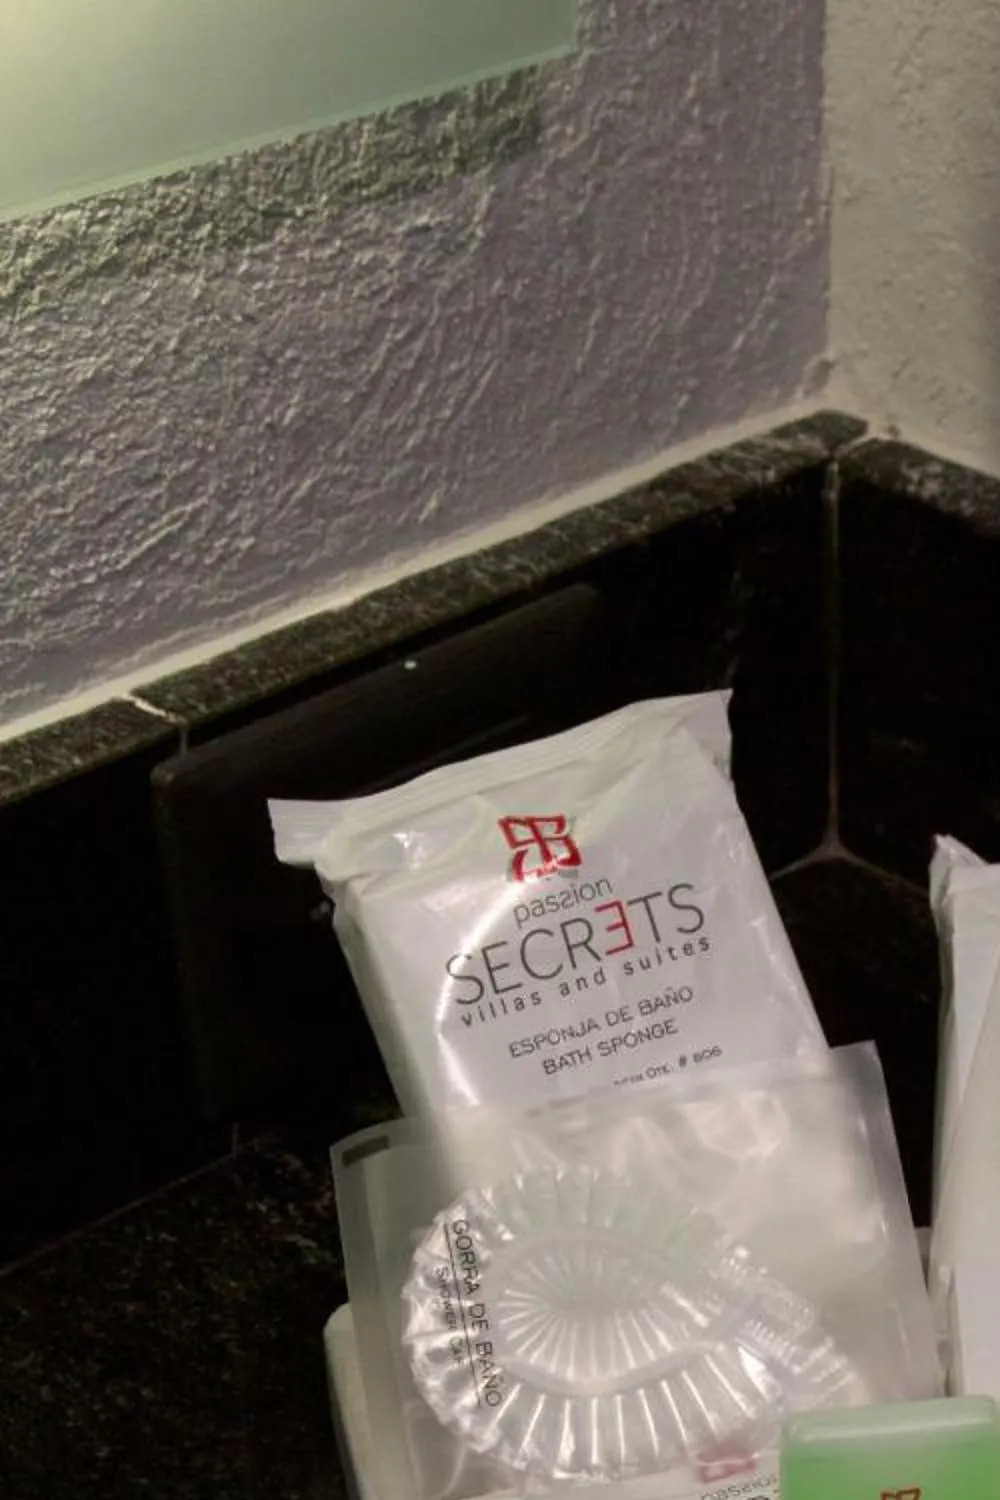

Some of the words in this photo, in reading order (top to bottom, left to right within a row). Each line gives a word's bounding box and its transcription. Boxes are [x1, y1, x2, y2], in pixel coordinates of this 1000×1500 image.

[513, 878, 614, 929] passion
[461, 990, 543, 1028] villas
[559, 966, 607, 998] and
[623, 936, 711, 976] suites
[508, 1012, 601, 1058] ESPONJA
[604, 1003, 634, 1027] DE
[638, 985, 694, 1017] BAÑO
[542, 1048, 593, 1076] BATH
[598, 1019, 679, 1057] SPONGE
[452, 1219, 482, 1296] GORRA
[468, 1303, 490, 1332] DE
